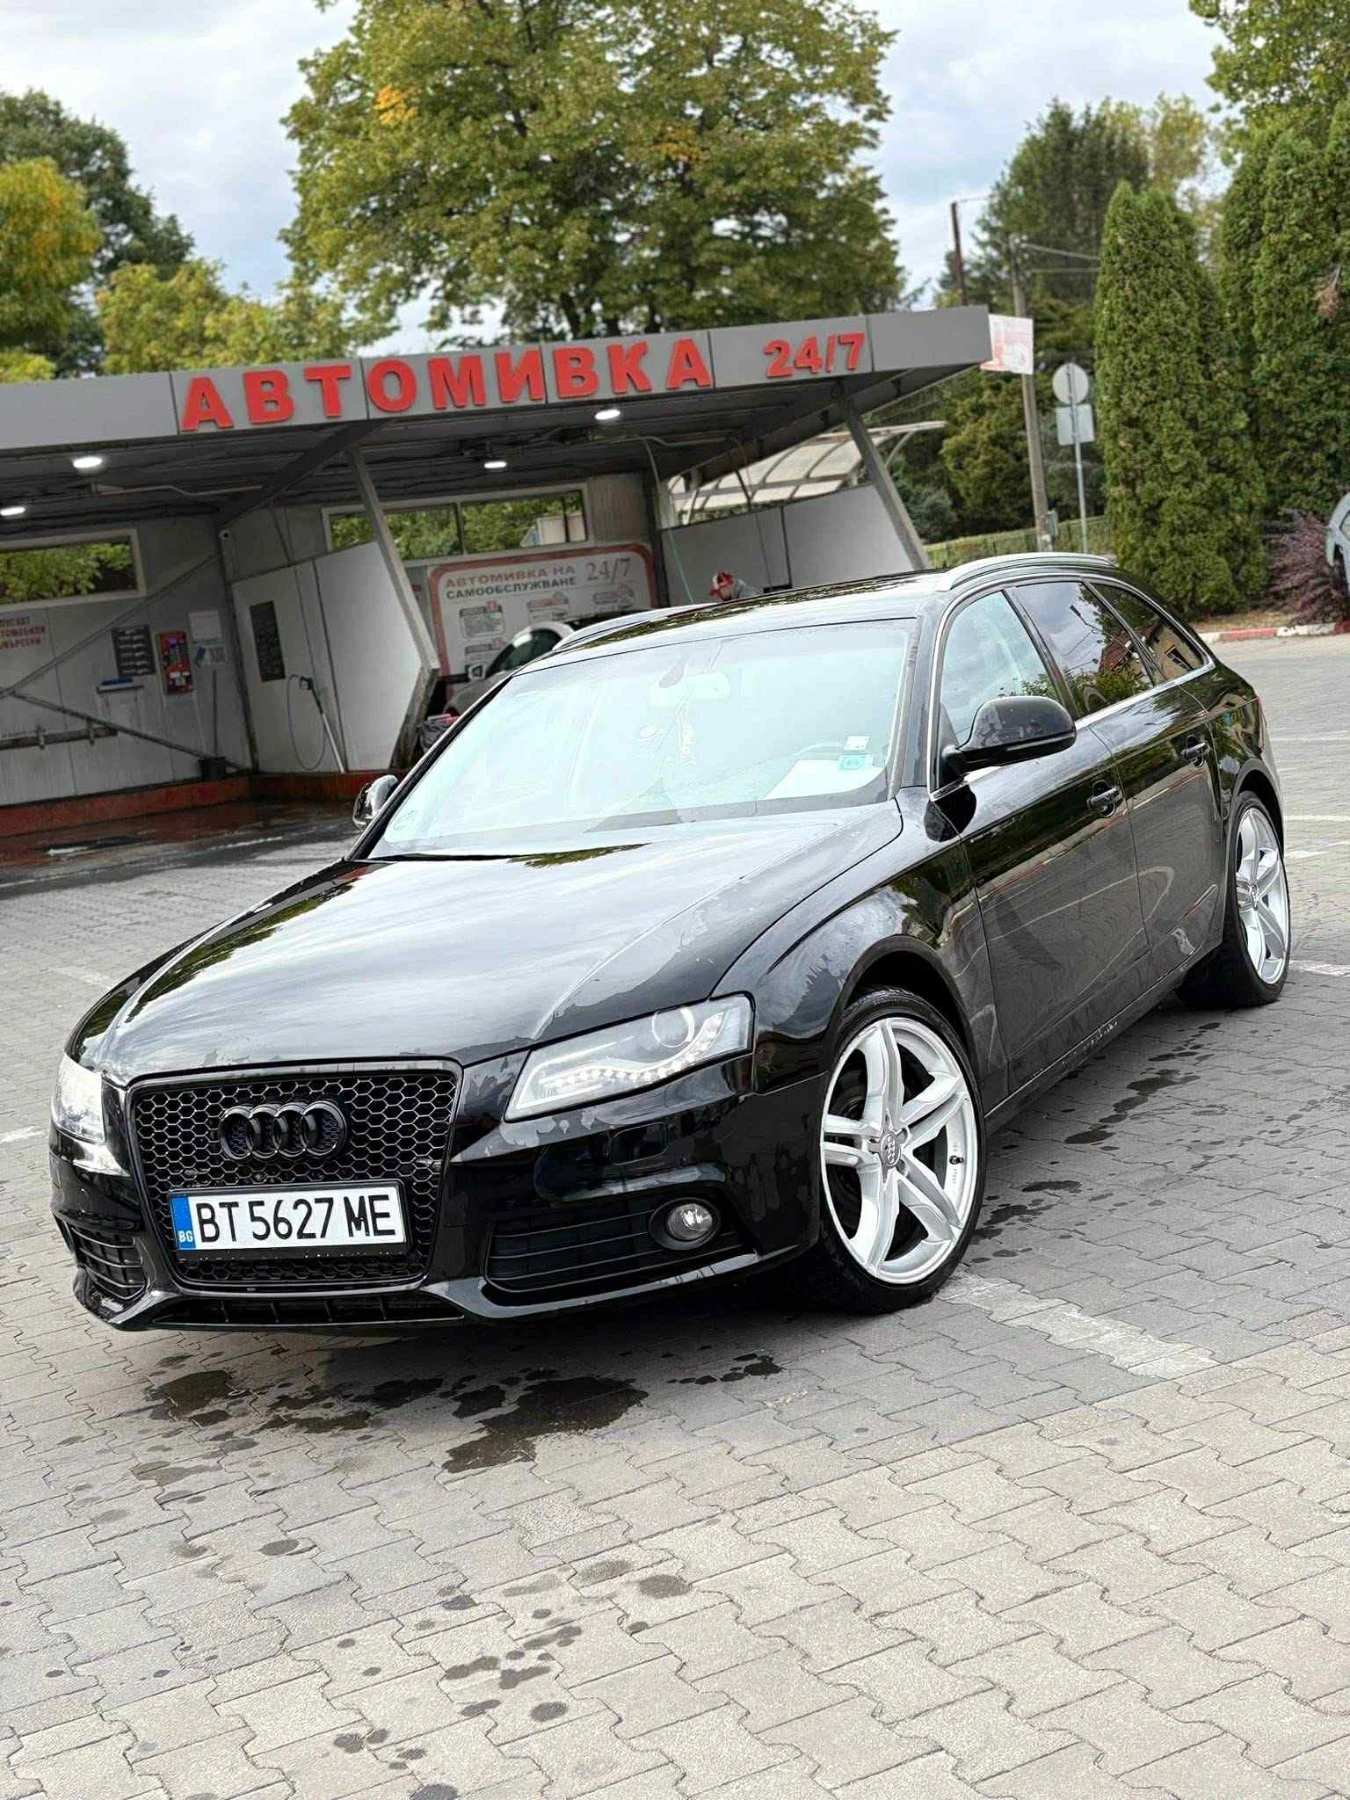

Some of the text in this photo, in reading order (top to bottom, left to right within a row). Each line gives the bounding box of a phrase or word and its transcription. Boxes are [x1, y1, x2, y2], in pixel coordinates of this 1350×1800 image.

[181, 332, 866, 432] АВТОМИВКА 24/7
[446, 557, 631, 588] АВТОМИВКА НА 24/7
[446, 576, 577, 600] САМООБСЛУЖВАНЕ
[196, 1195, 396, 1242] BT 5627 ME
[178, 1231, 193, 1243] BG
